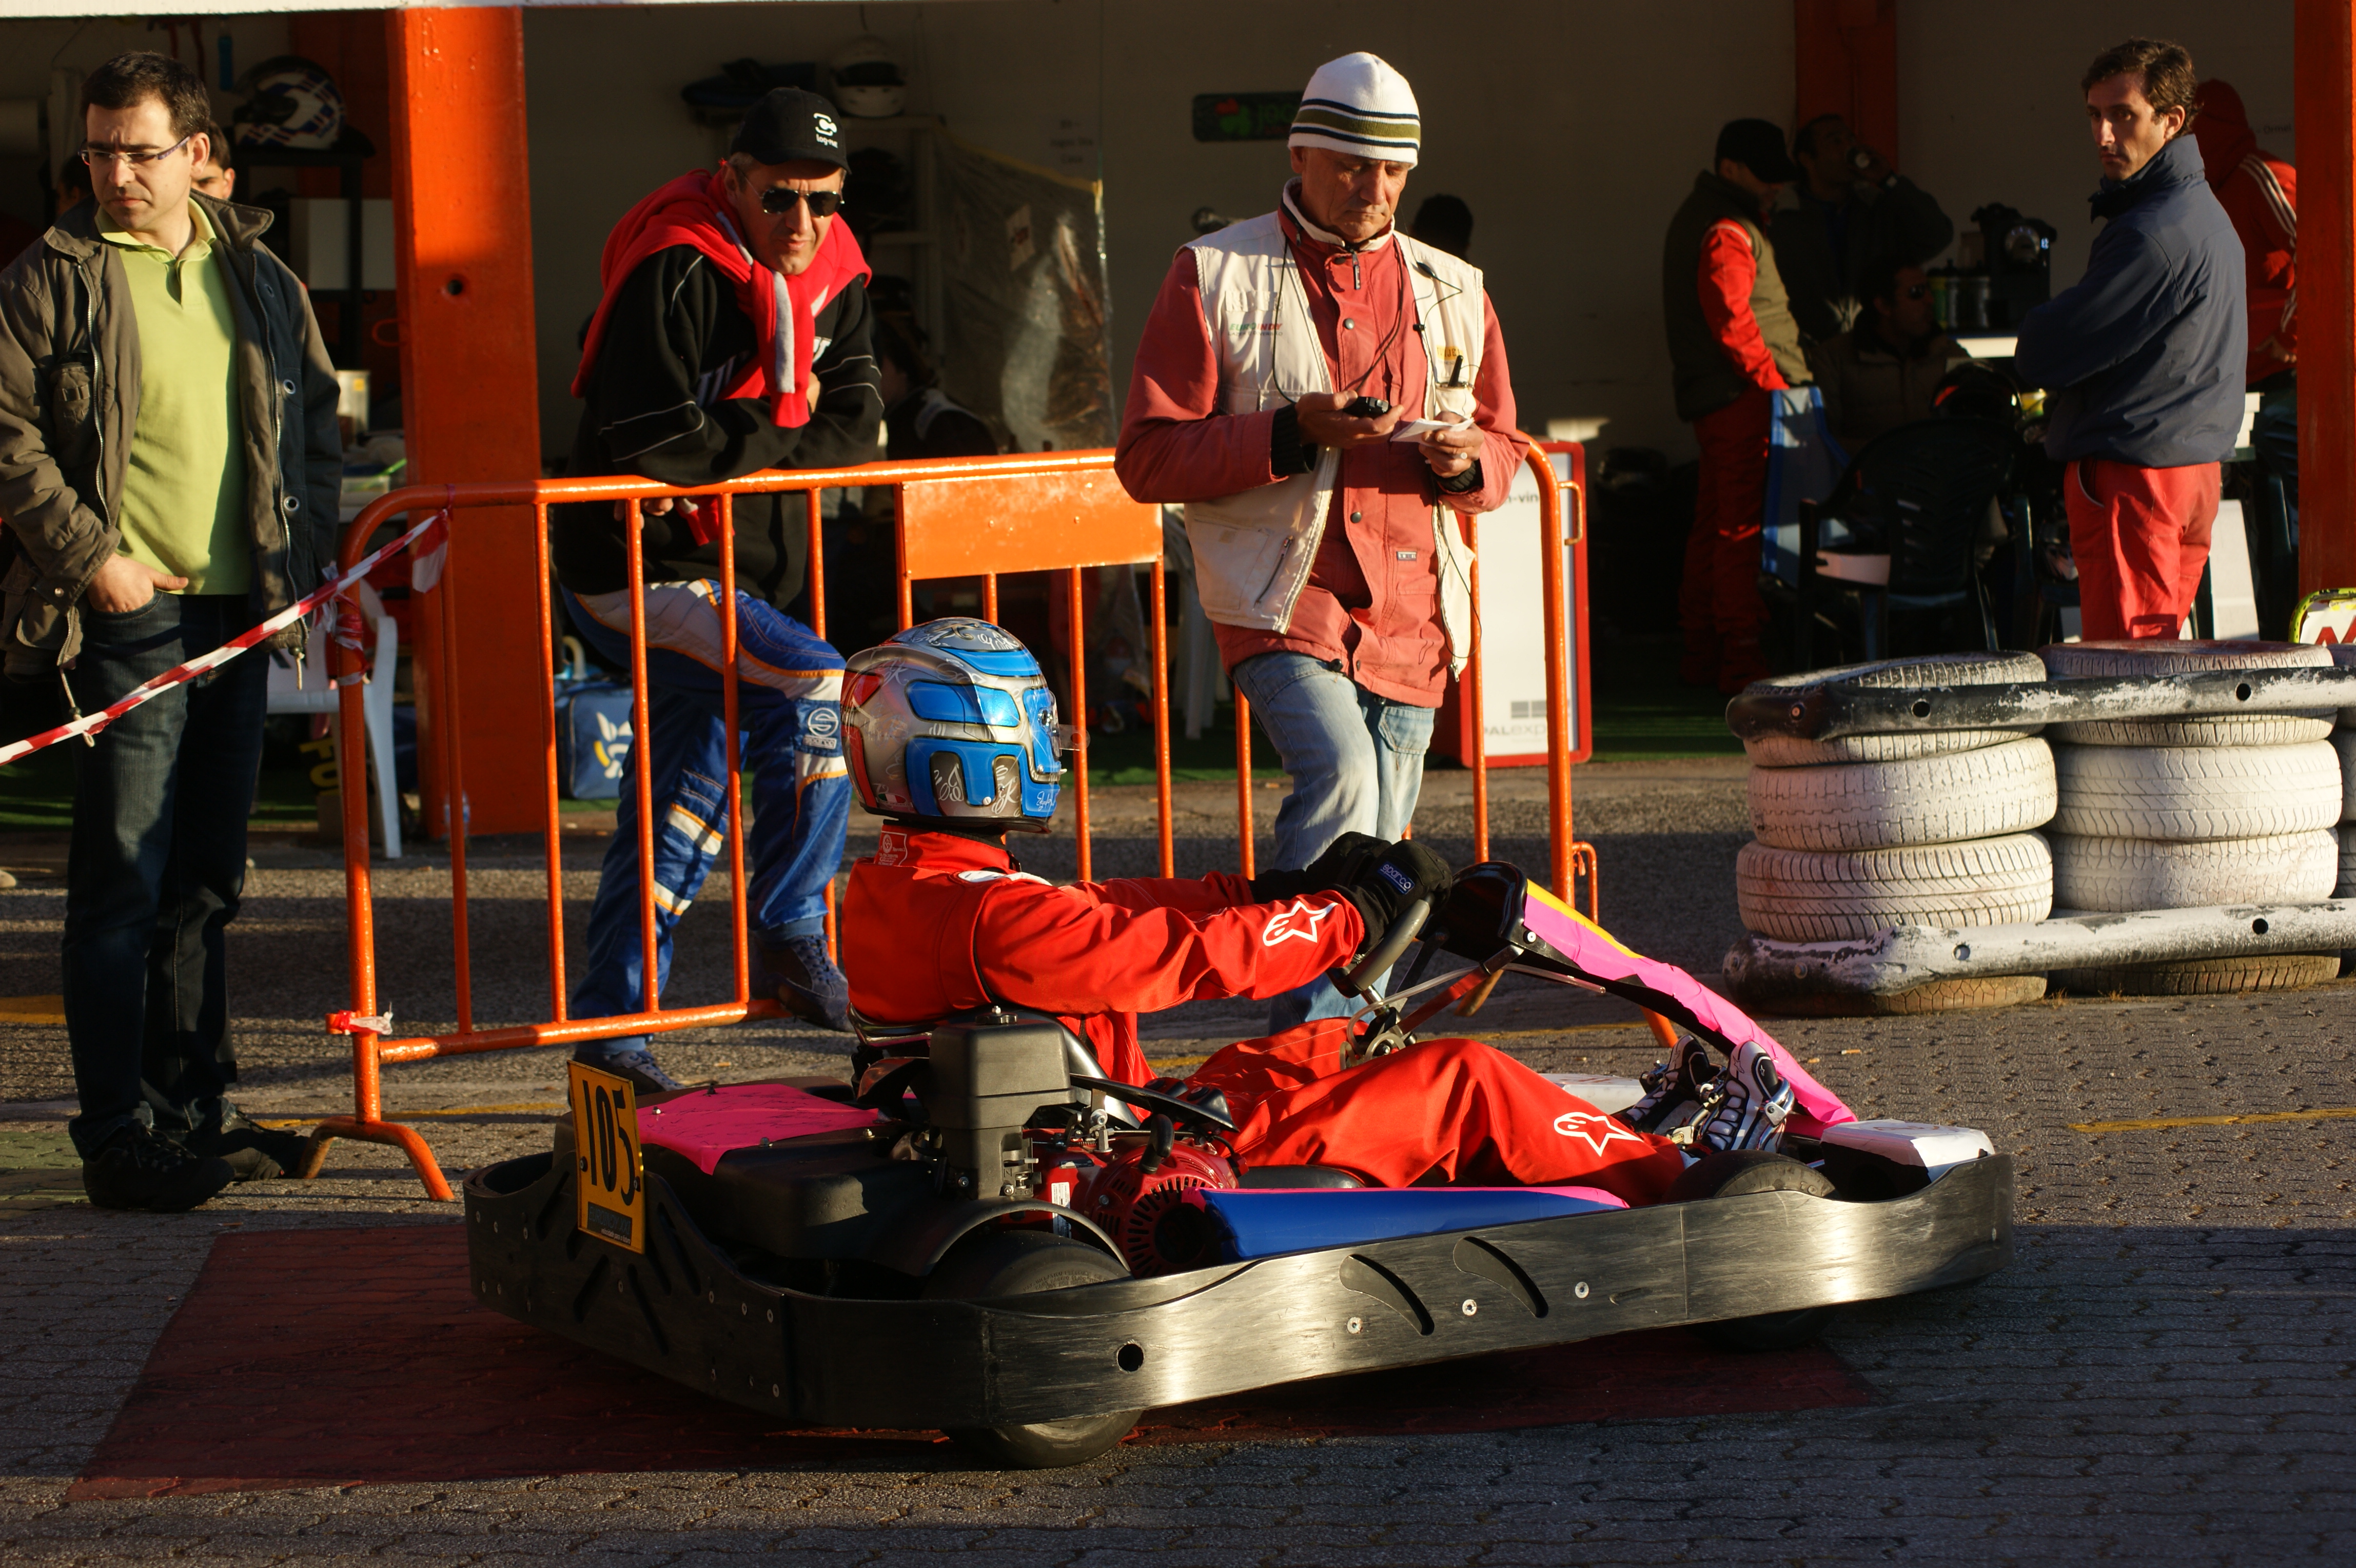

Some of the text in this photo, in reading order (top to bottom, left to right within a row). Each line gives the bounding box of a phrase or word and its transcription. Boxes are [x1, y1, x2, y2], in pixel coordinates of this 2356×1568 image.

[1382, 864, 1411, 890] sparco
[582, 1080, 636, 1206] 105
[588, 1206, 619, 1229] EUROINDY
